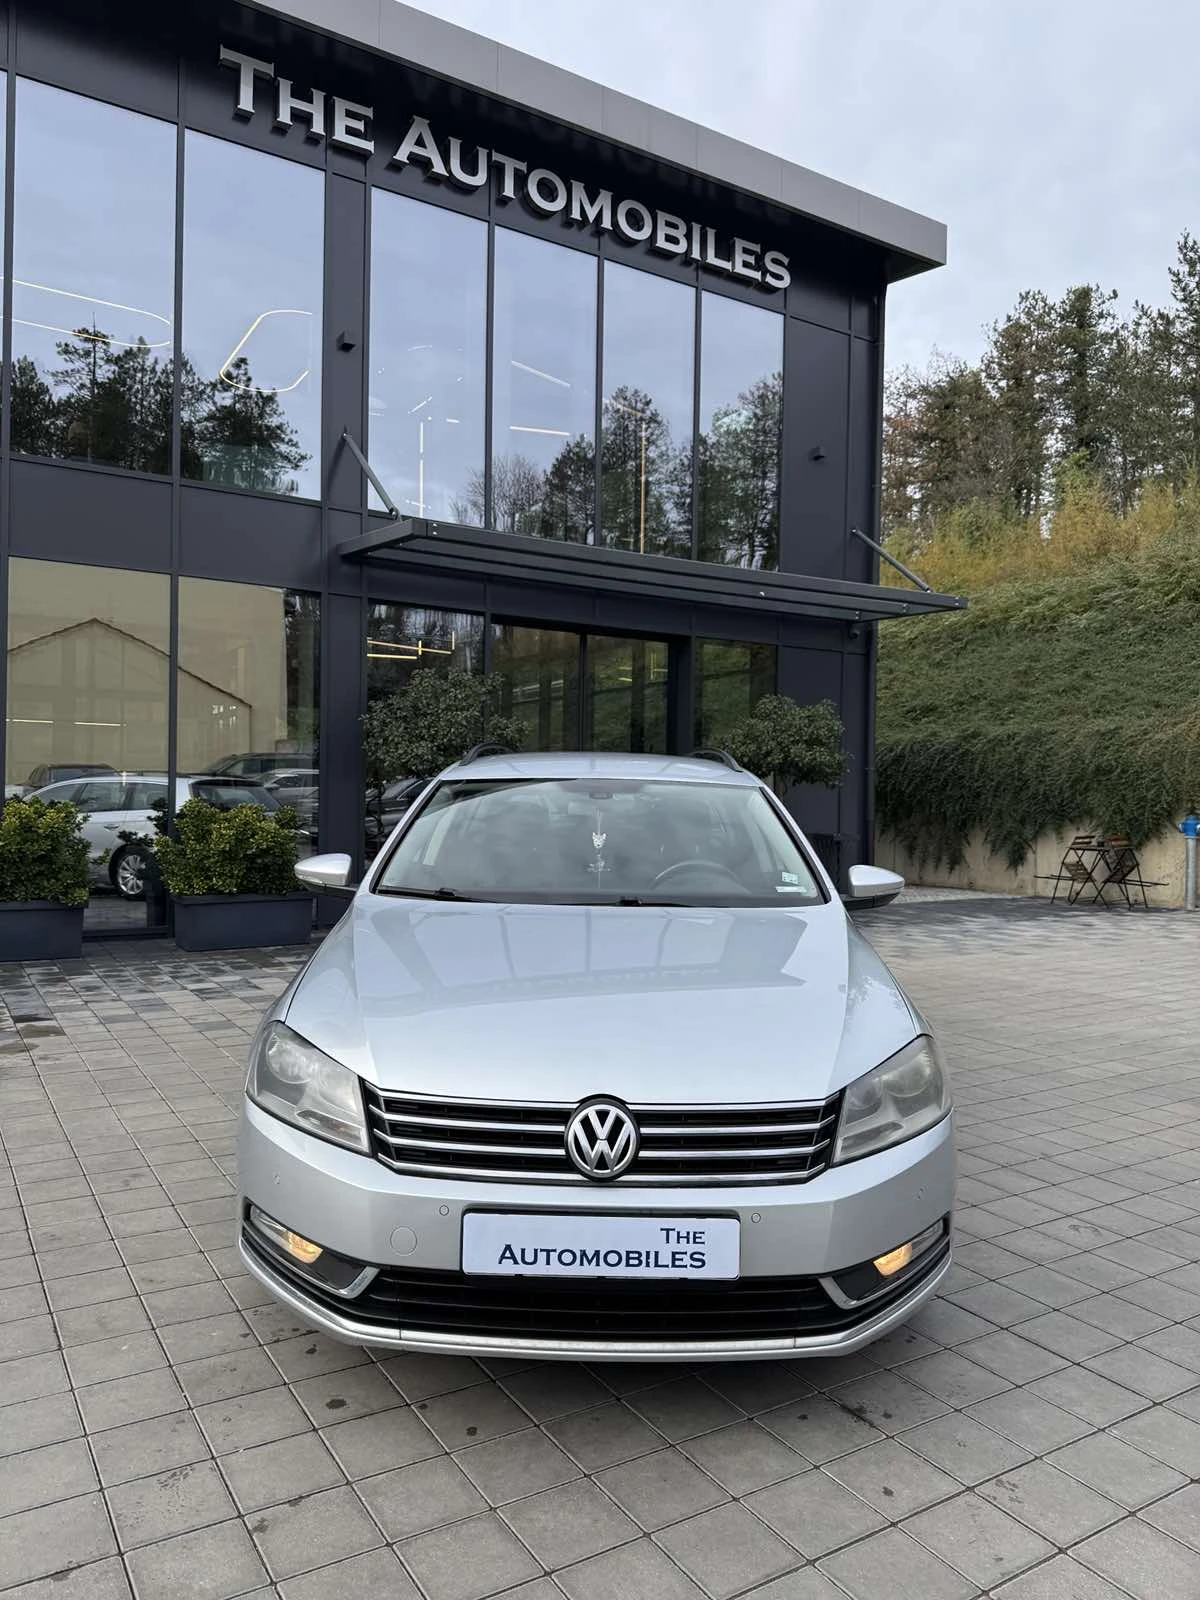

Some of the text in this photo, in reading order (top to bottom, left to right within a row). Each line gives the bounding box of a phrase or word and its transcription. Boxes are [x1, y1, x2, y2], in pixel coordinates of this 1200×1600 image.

[219, 45, 792, 290] THE AUTOMOBILES
[569, 1105, 635, 1175] VW
[498, 1244, 706, 1269] AUTOMOBILES
[660, 1227, 705, 1244] THE
